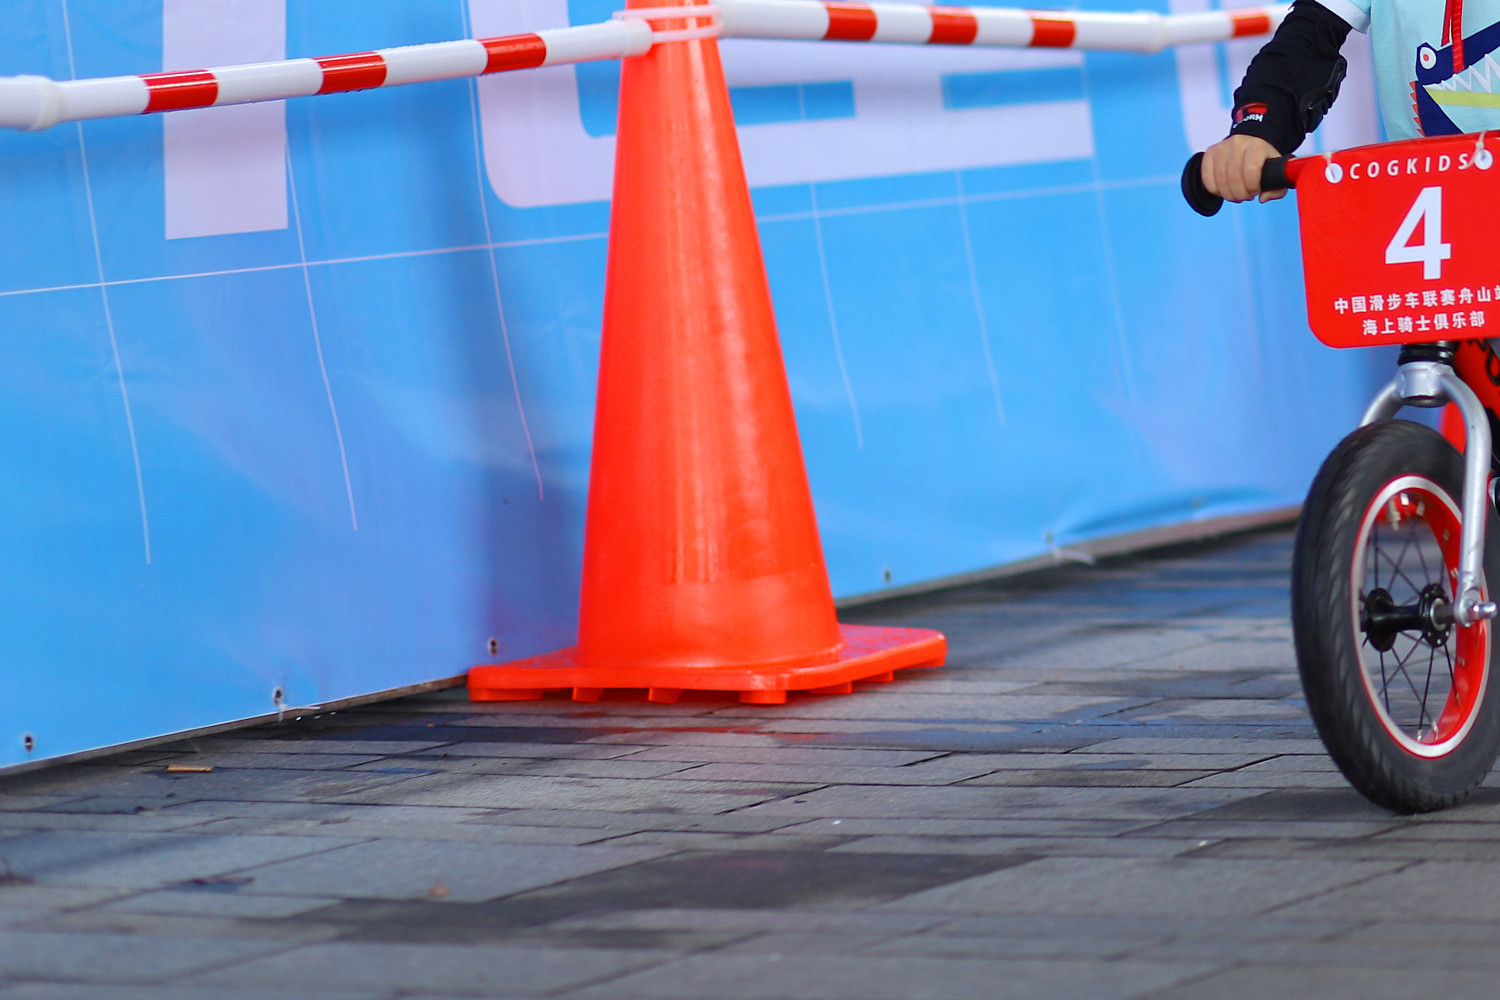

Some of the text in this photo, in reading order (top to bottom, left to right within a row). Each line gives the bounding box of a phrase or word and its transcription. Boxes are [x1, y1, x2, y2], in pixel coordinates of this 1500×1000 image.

[1349, 152, 1471, 180] COGKIDS
[1384, 186, 1451, 280] 4
[1361, 310, 1486, 337] 海上骑士俱乐部
